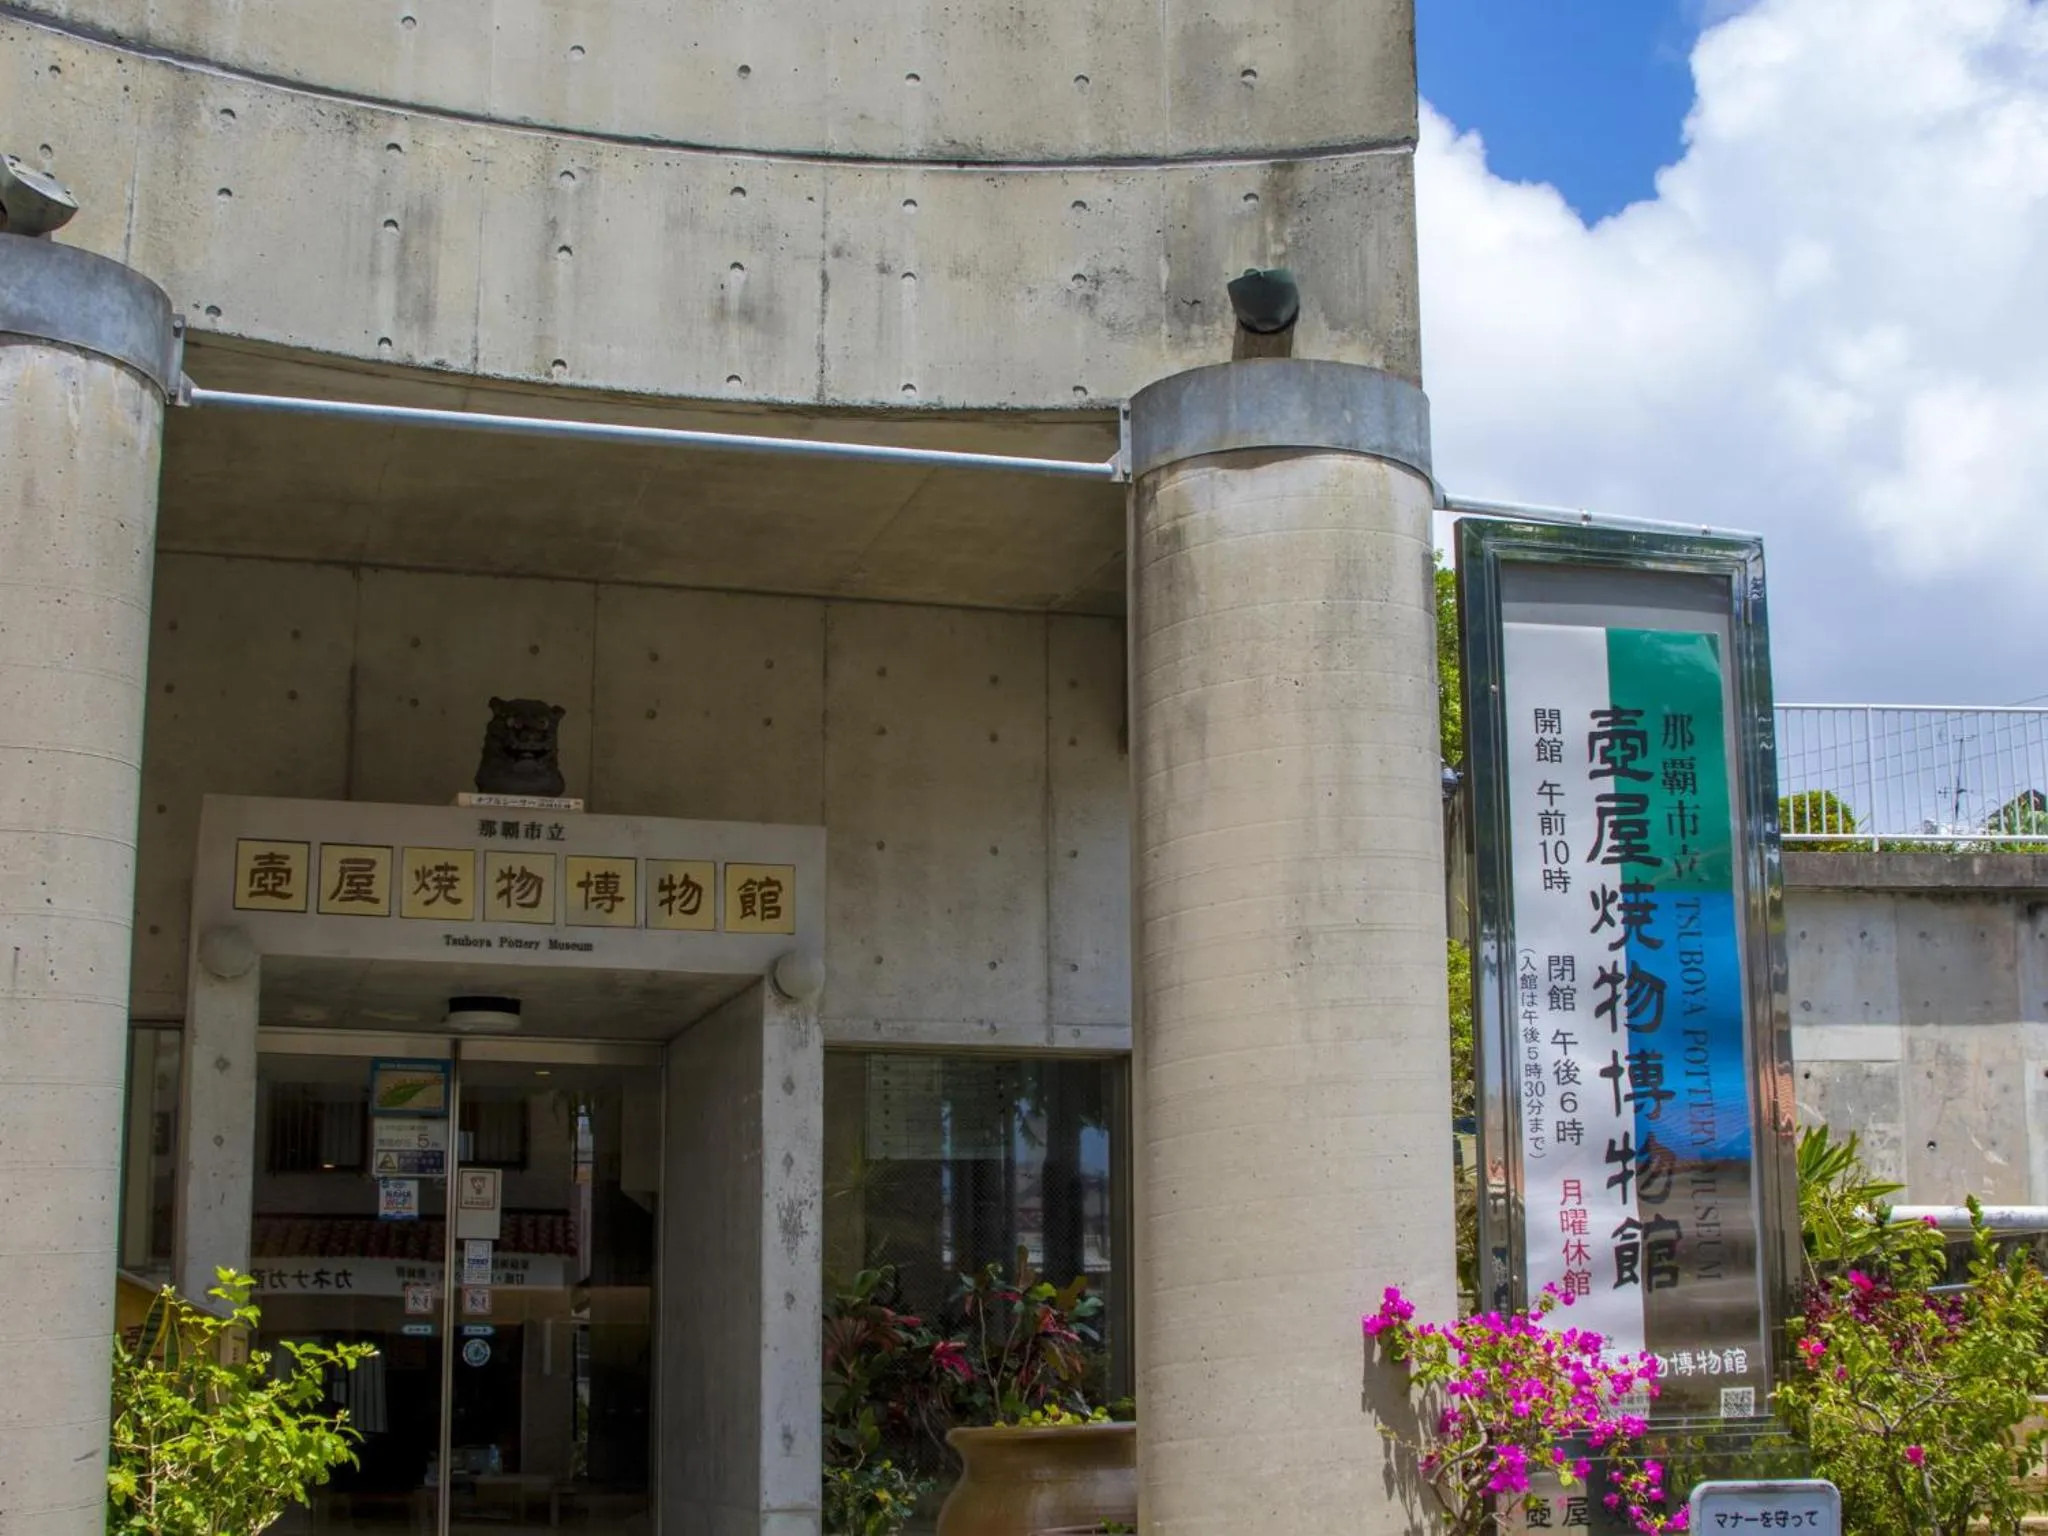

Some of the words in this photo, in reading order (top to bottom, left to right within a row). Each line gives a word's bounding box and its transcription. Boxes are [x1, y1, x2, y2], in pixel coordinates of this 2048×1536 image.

[1534, 708, 1564, 766] 開館
[443, 934, 493, 949] Tsuboya
[498, 936, 541, 951] Pottery
[548, 939, 593, 952] Museum
[1675, 896, 1707, 1017] TSUBOYA
[1547, 955, 1577, 1012] 閉館
[1560, 1179, 1592, 1297] 月曜休館
[1715, 1510, 1819, 1528] マナーを守って
